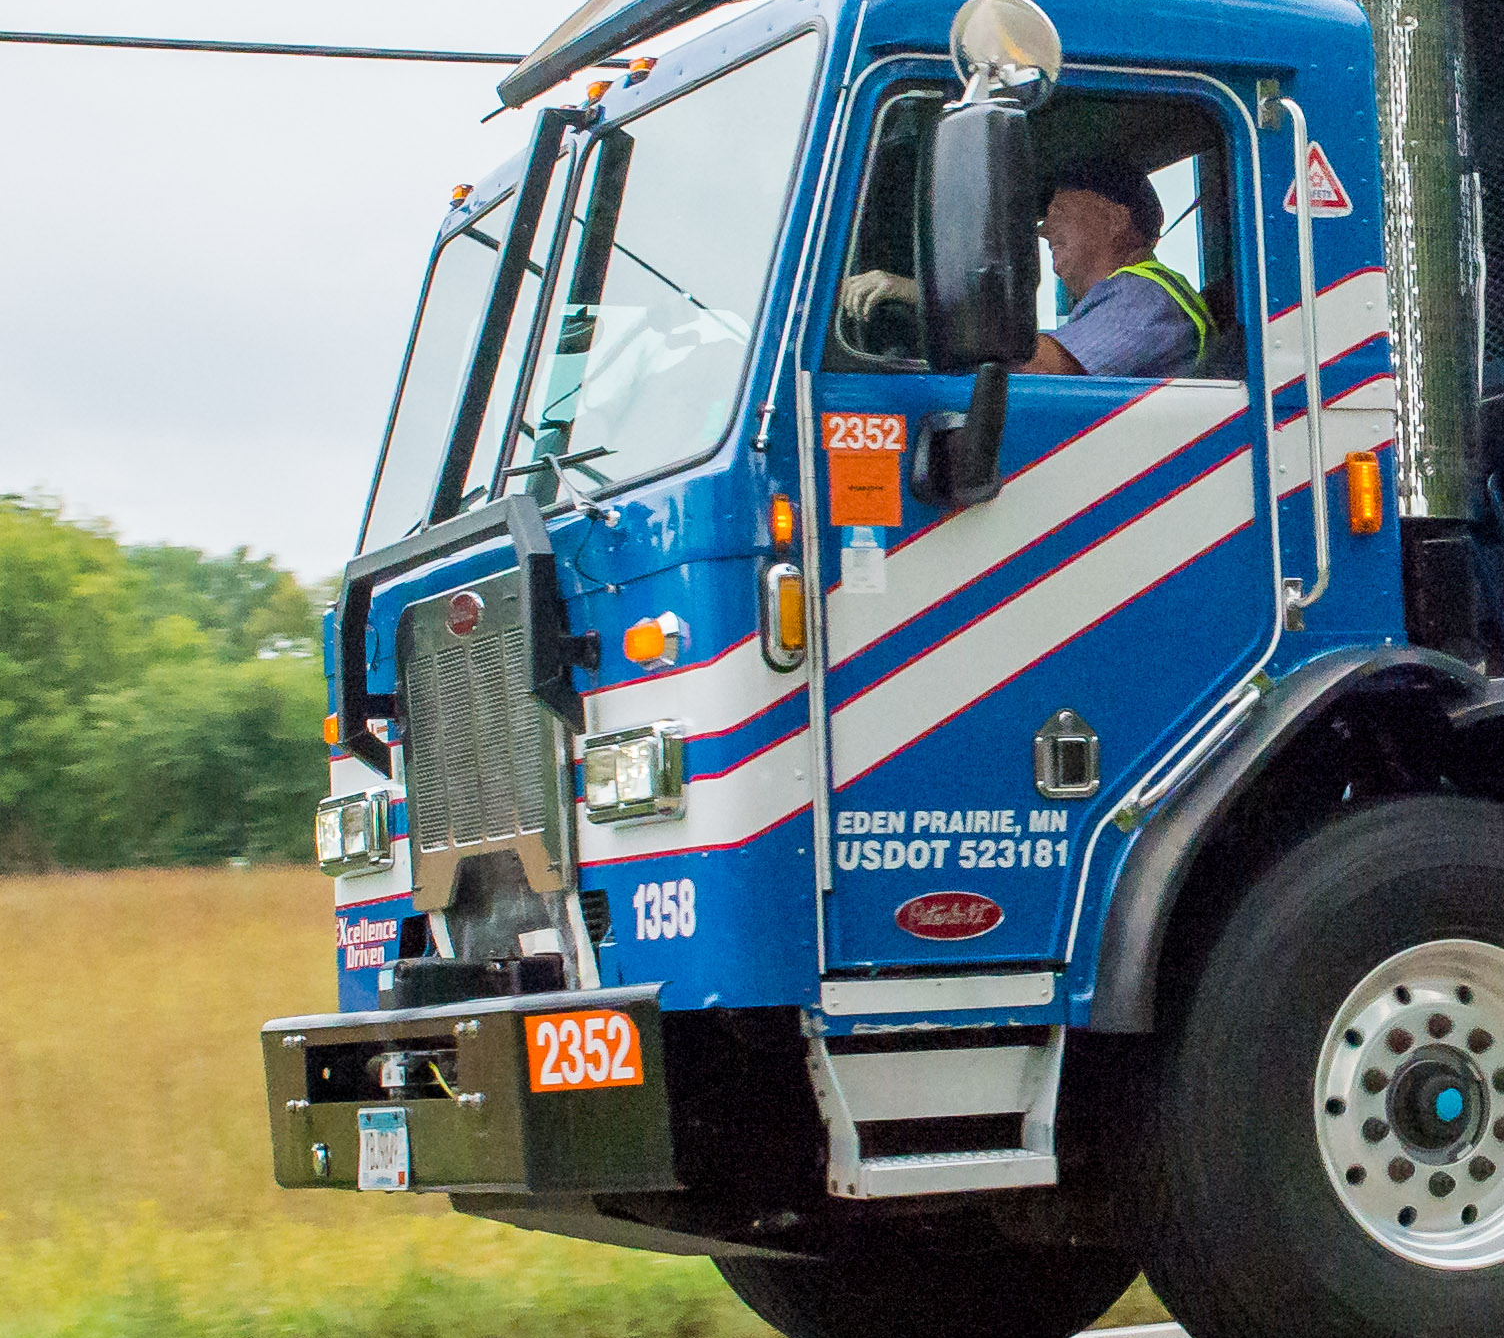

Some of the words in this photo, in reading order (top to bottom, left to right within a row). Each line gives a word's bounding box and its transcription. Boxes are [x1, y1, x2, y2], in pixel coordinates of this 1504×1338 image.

[828, 416, 902, 450] 2352
[836, 810, 906, 835] EDEN
[913, 809, 1022, 837] PRAIRIE,
[1028, 809, 1068, 834] MN
[836, 840, 945, 871] USDOT
[958, 838, 1069, 869] 523181
[632, 877, 696, 942] 1358
[345, 944, 385, 971] Driven
[536, 1014, 635, 1086] 2352
